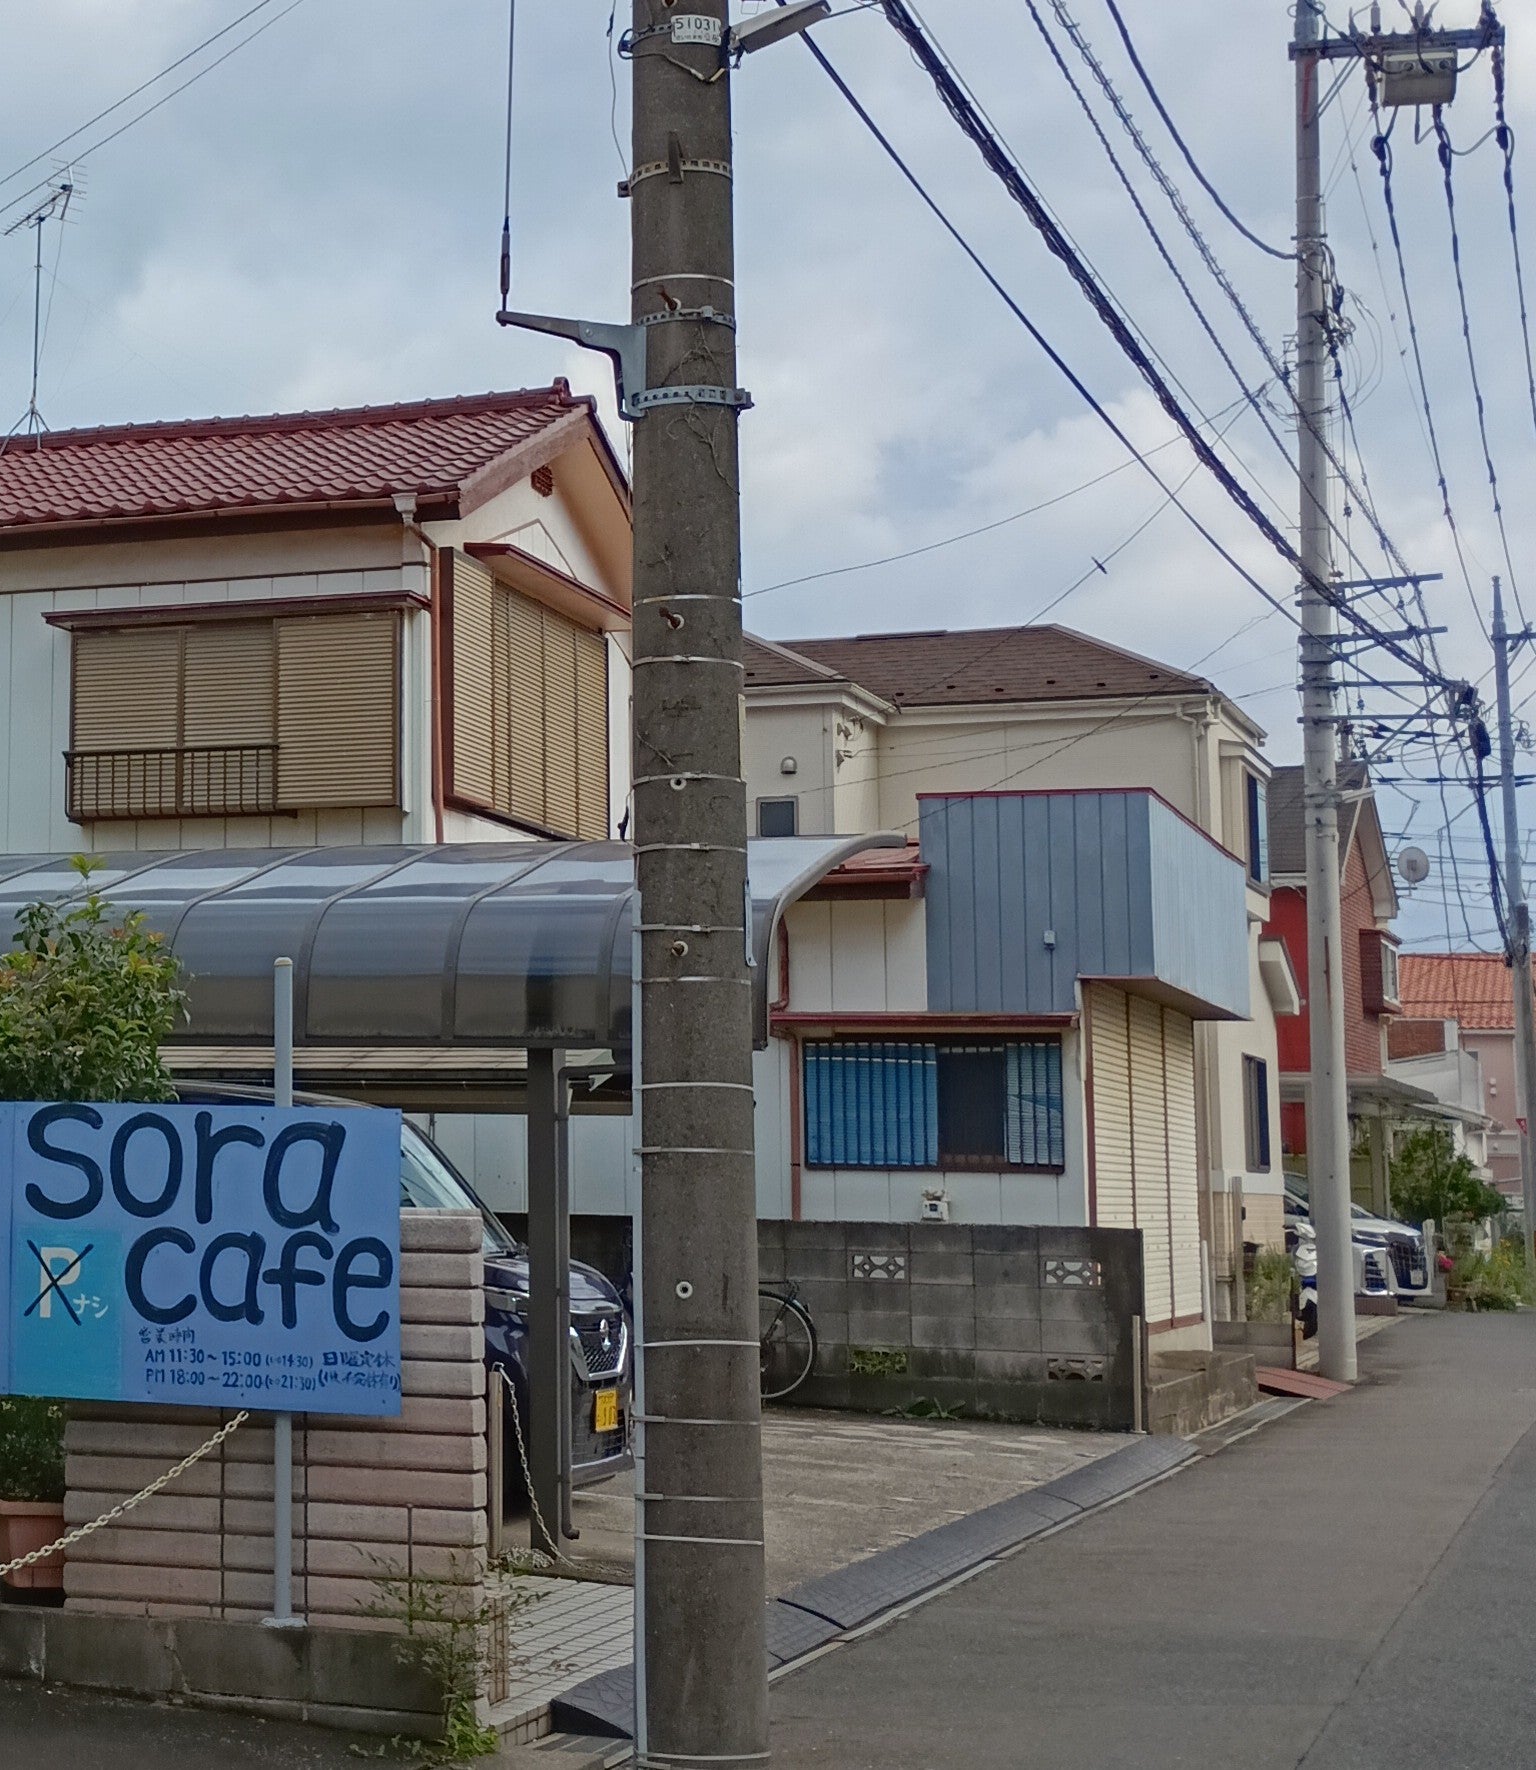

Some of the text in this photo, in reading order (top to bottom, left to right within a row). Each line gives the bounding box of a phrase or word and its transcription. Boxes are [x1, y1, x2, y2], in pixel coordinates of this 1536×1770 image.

[25, 1101, 347, 1233] sora
[124, 1224, 394, 1343] cafe
[144, 1348, 165, 1364] AM
[145, 1368, 165, 1384] PM
